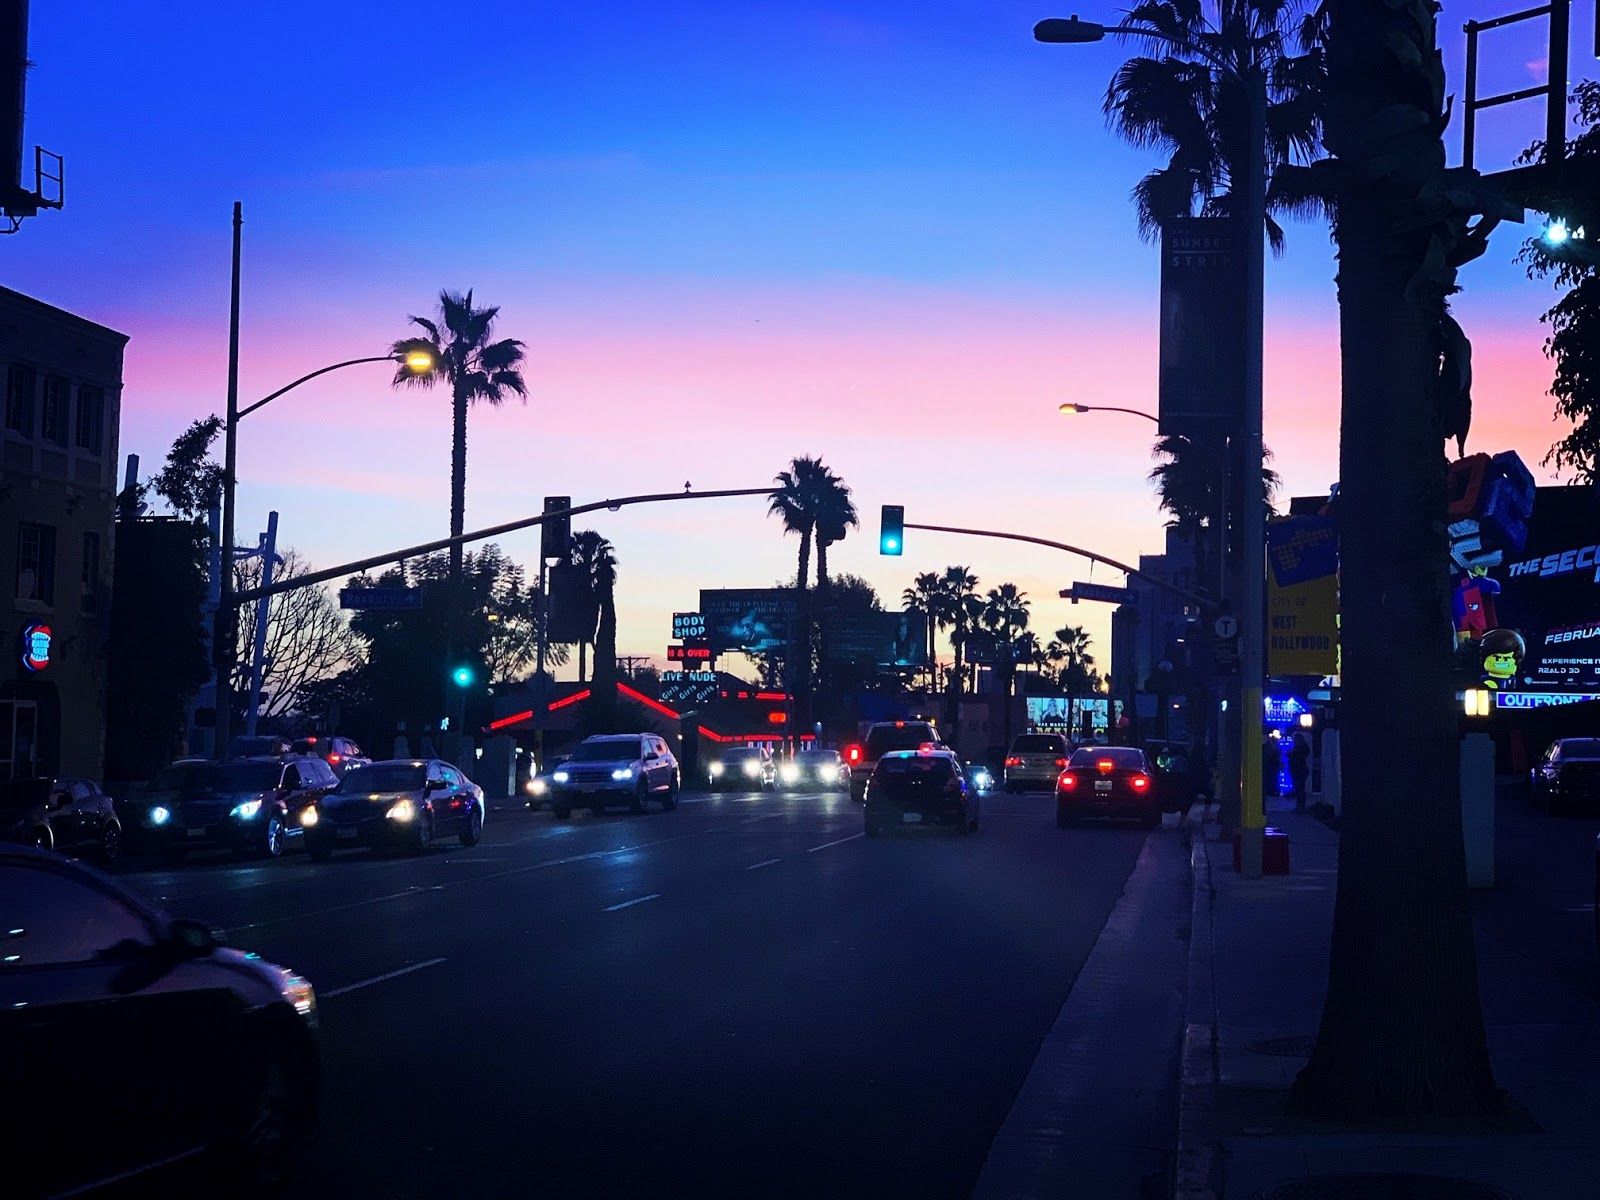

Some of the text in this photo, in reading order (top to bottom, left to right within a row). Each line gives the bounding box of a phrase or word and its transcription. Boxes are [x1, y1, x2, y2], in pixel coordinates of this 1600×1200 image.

[1172, 238, 1232, 248] SUNSET
[1172, 256, 1232, 268] STRIP
[1509, 558, 1541, 577] THE
[675, 616, 705, 627] BODY
[1221, 620, 1231, 635] T
[1272, 615, 1296, 630] WEST
[674, 626, 705, 637] SHOP
[1272, 635, 1329, 650] HOLLYWOOD
[677, 649, 684, 658] &
[687, 649, 710, 658] OVER
[661, 672, 717, 682] LIVE NUDE
[662, 685, 679, 700] Girls
[679, 684, 697, 700] Girls
[697, 685, 715, 700] Girls
[1505, 694, 1583, 707] OUTFRONT
